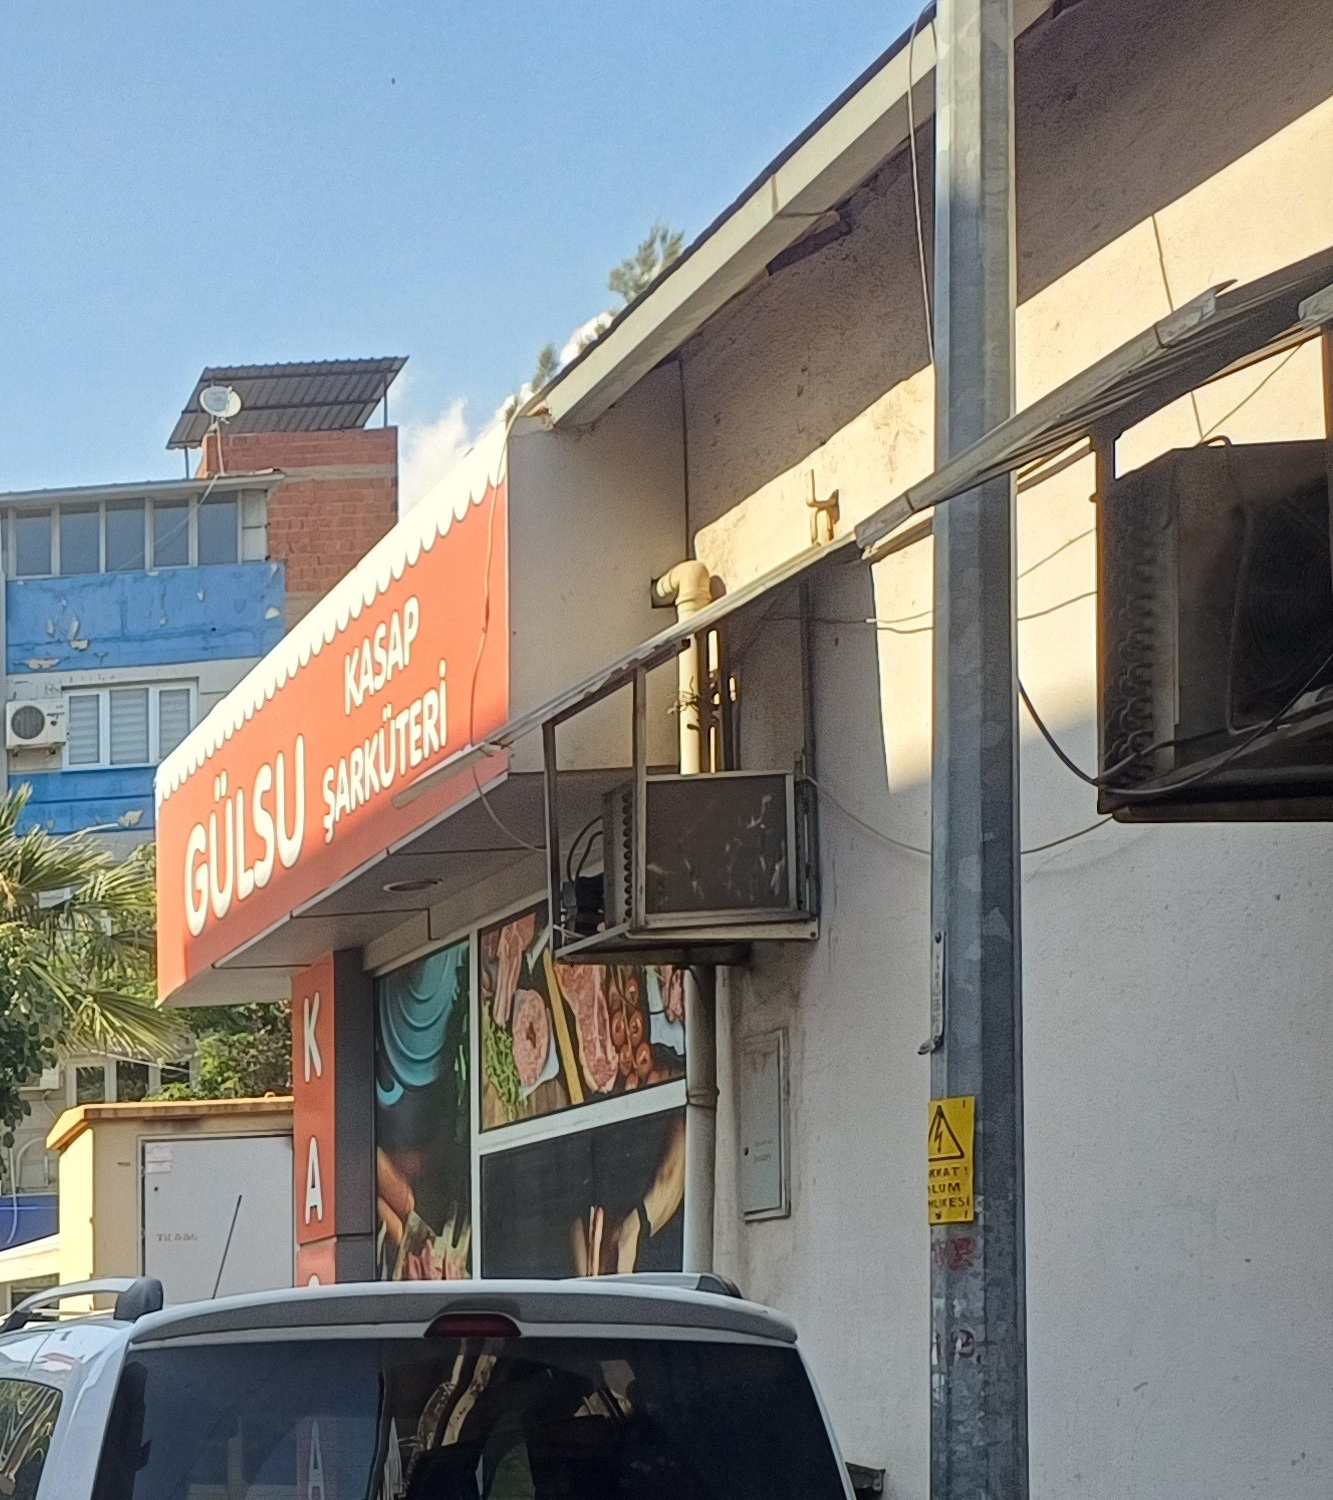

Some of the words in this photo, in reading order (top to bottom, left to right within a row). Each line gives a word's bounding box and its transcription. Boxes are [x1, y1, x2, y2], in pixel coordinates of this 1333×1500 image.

[344, 595, 420, 717] KASAP
[184, 733, 305, 937] GÜLSU
[322, 658, 447, 844] ŞARKÜTERİ
